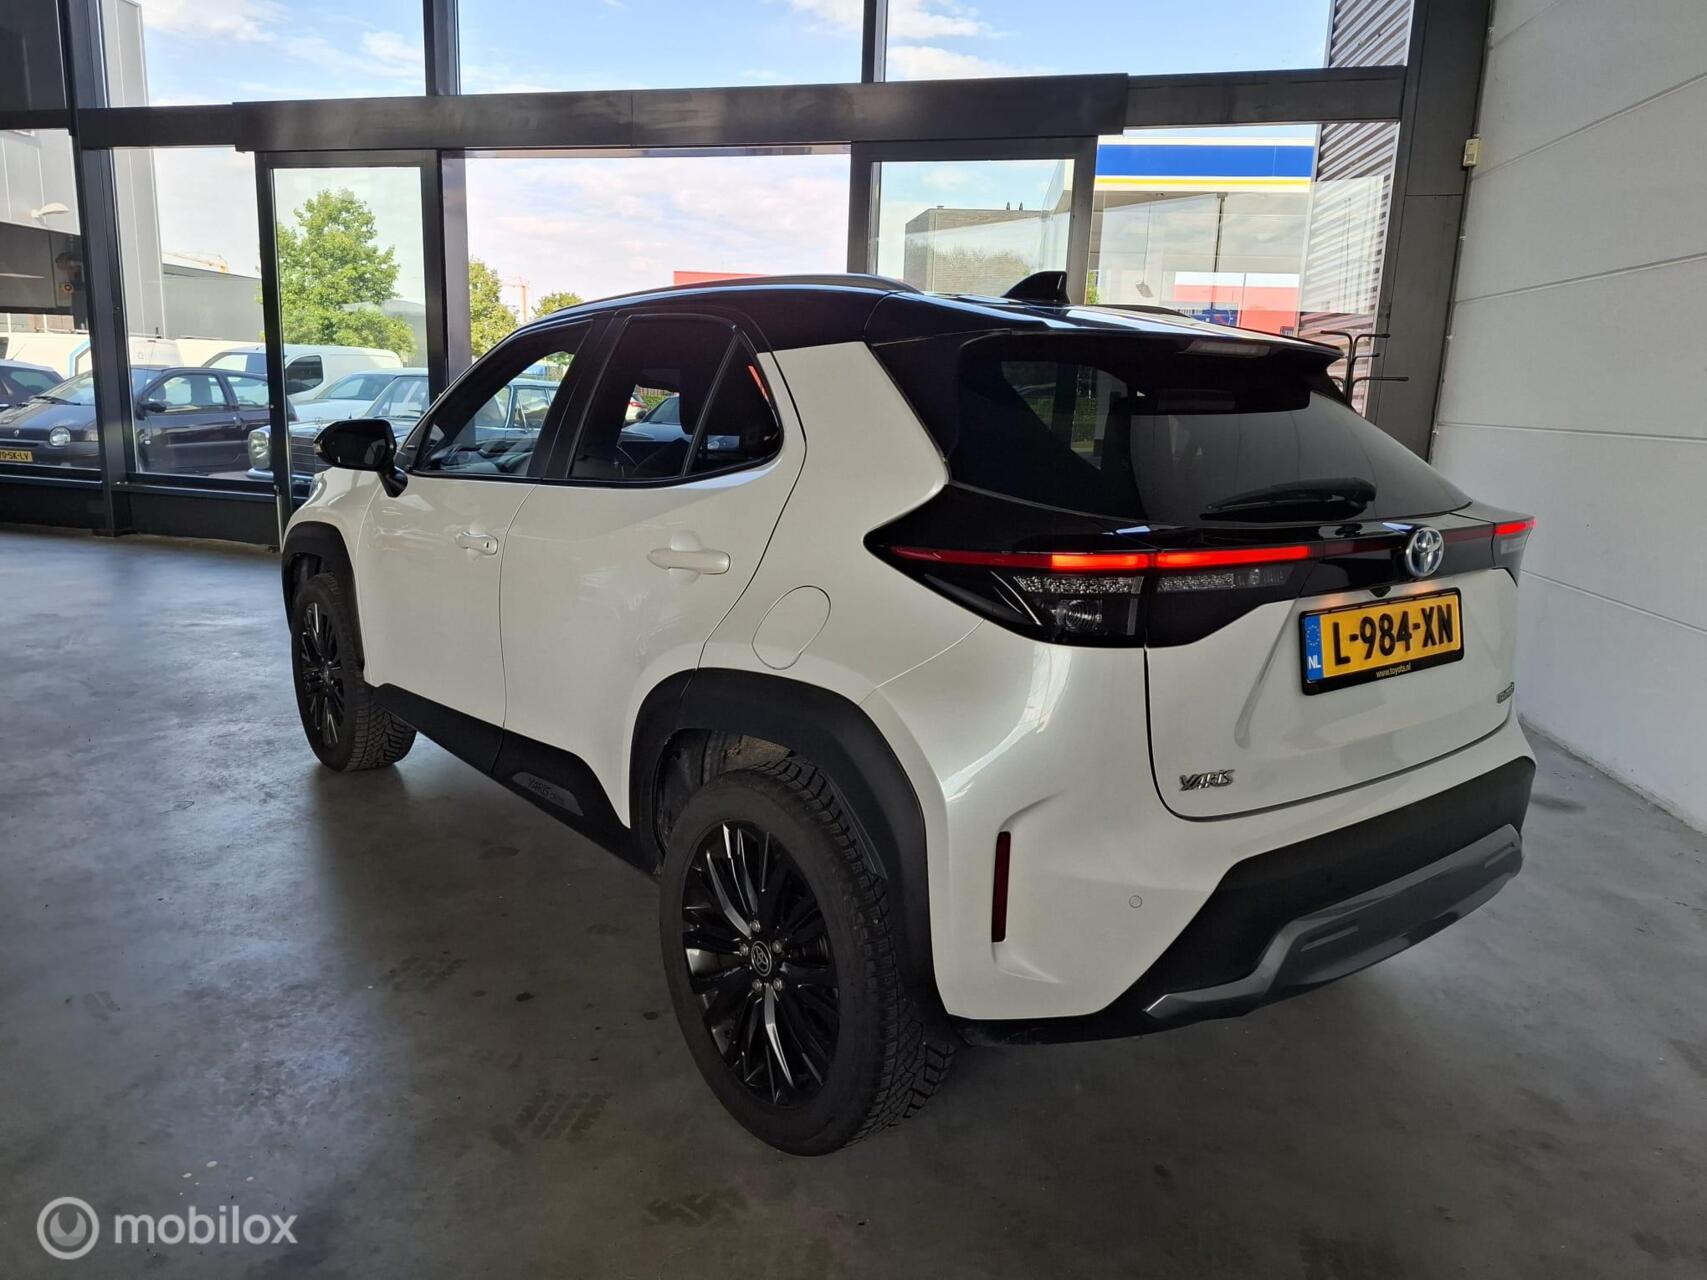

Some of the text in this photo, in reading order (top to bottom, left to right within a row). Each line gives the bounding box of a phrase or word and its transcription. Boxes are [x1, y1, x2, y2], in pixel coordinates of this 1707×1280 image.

[1332, 603, 1454, 666] L-984-XN
[1307, 655, 1322, 670] NL
[1179, 769, 1235, 791] YARIS
